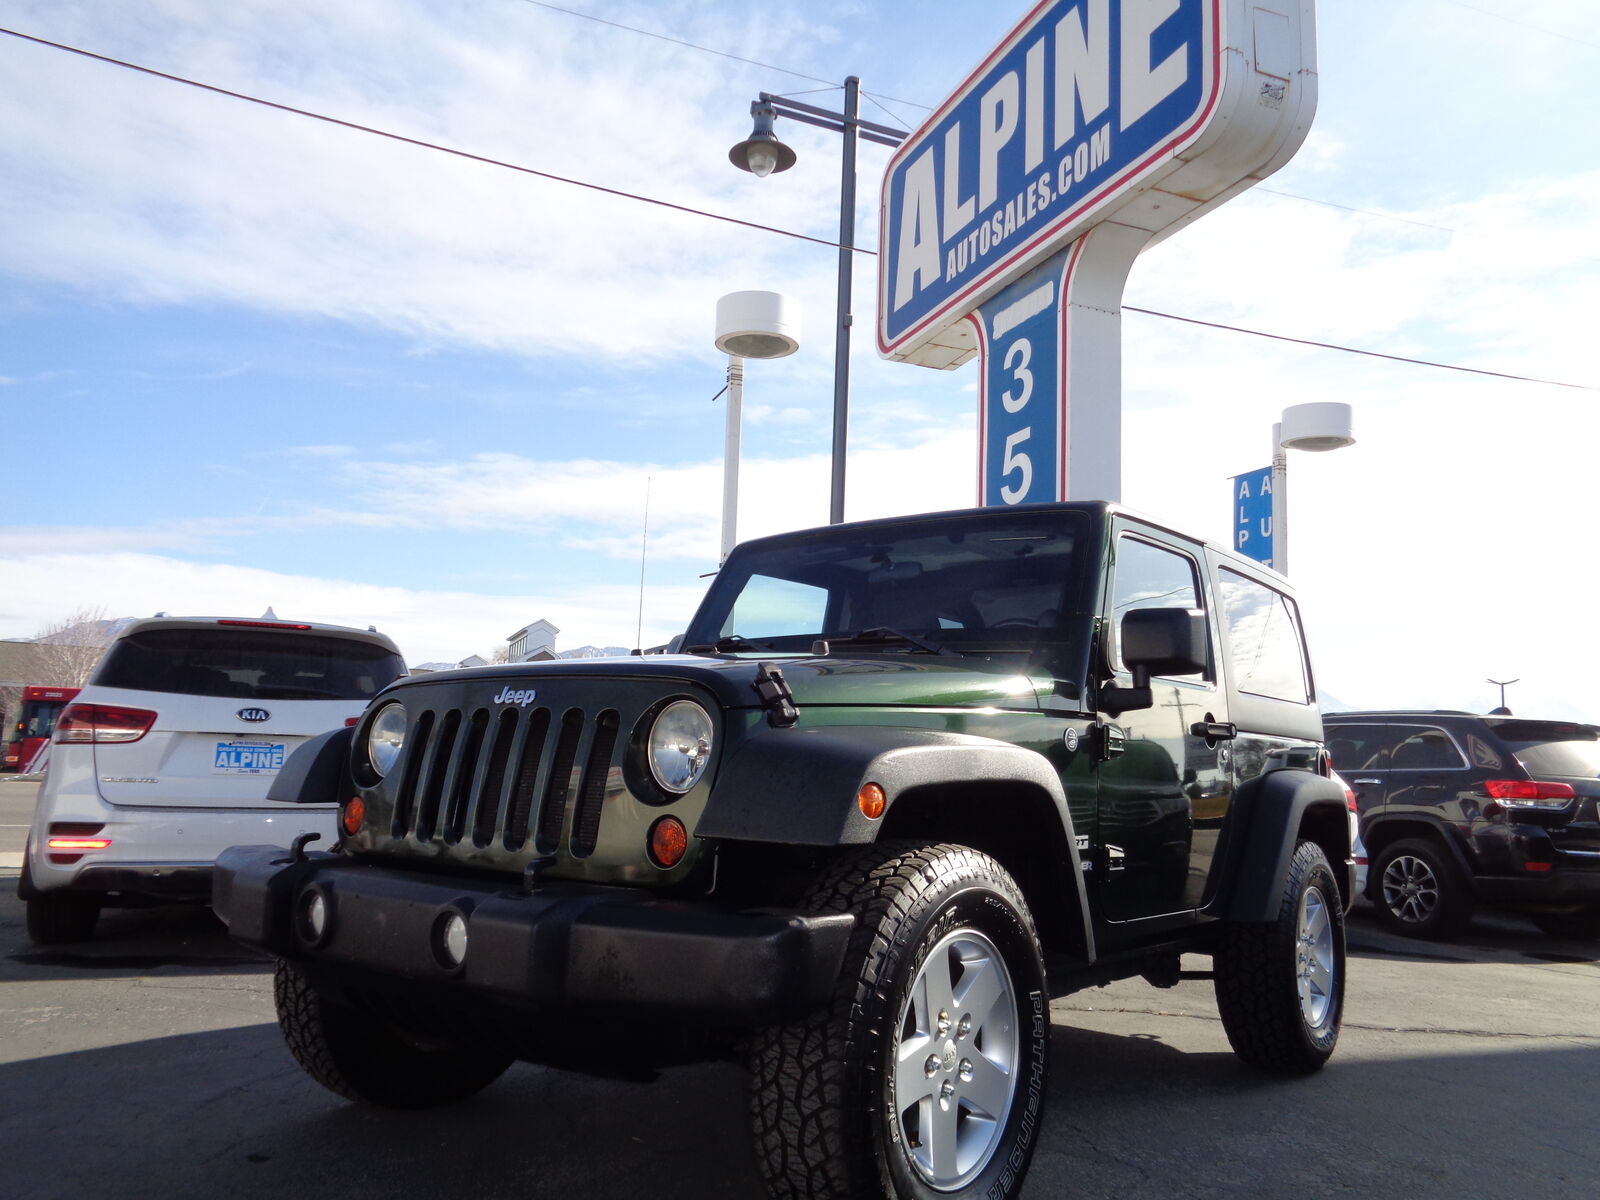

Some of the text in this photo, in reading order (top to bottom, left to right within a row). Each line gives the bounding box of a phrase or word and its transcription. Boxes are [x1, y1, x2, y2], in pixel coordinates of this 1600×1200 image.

[894, 0, 1188, 312] ALPINE
[945, 121, 1111, 284] AUTOSALES.COM
[494, 685, 536, 707] Jeep
[242, 709, 266, 720] KIA
[215, 752, 283, 768] ALPINE
